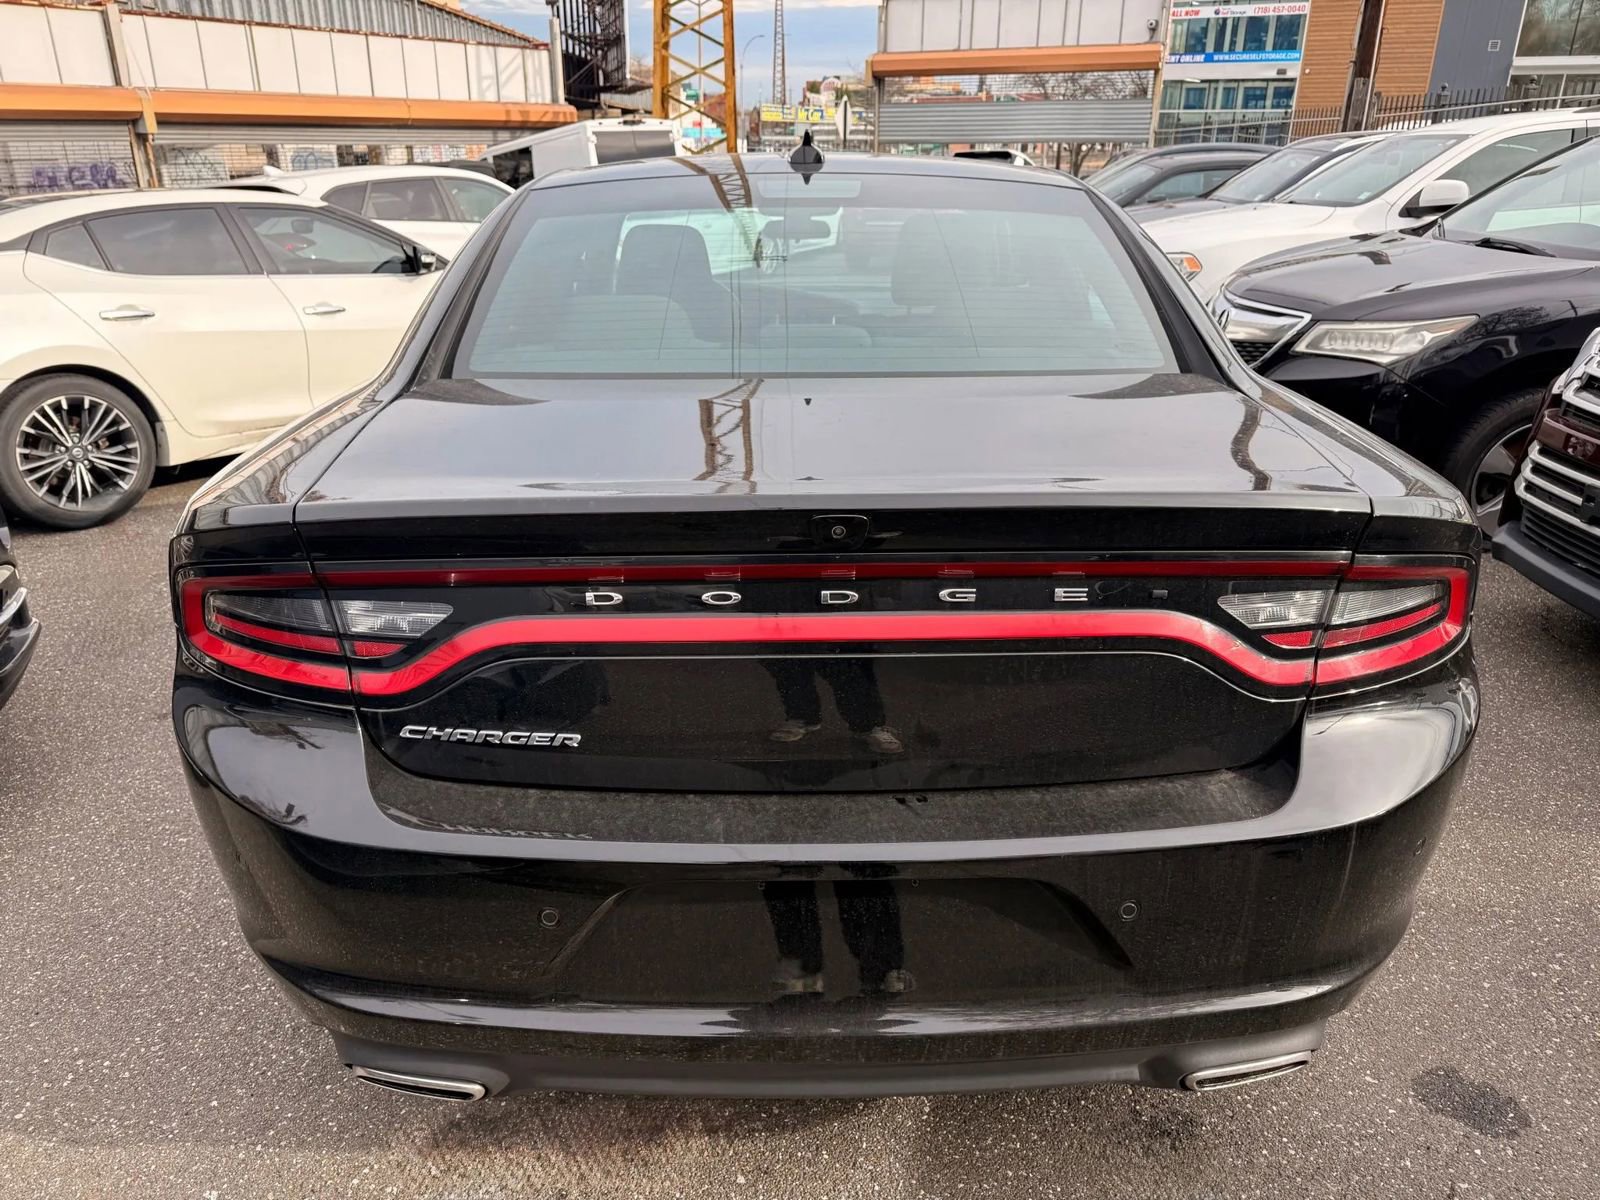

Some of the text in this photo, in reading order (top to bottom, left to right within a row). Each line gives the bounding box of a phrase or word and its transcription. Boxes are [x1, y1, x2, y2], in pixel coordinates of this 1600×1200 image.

[1253, 4, 1306, 15] (718) 457-0040
[1180, 54, 1205, 62] ONLINE
[1213, 51, 1300, 61] WWW.SECURESELFSTORAGE.COM
[585, 588, 1089, 606] DODGE
[399, 724, 582, 747] CHARGER
